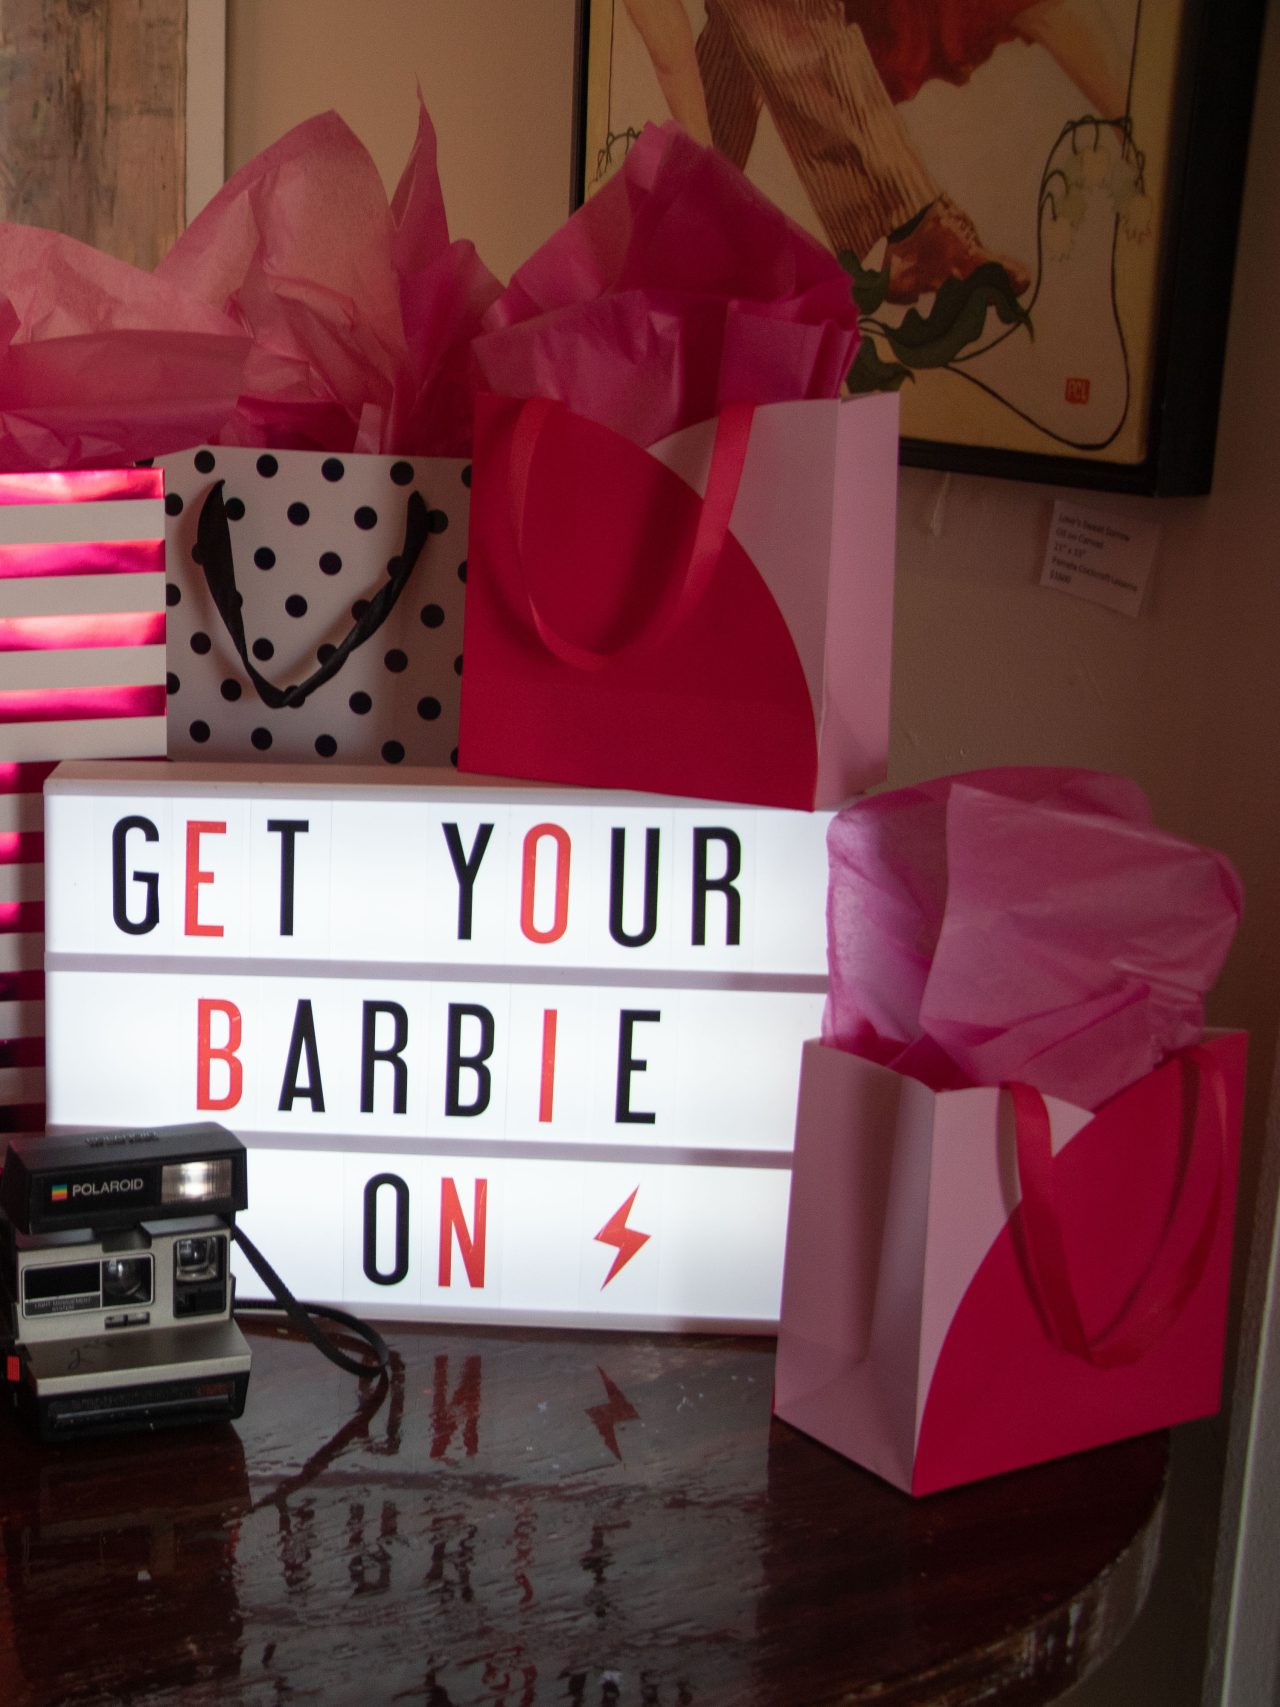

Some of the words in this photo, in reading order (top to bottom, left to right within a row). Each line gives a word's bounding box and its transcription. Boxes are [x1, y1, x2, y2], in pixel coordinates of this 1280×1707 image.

[112, 815, 310, 937] GET
[441, 822, 742, 948] YOUR
[196, 998, 661, 1125] BARBIE
[72, 1178, 144, 1198] POLAROID
[362, 1172, 488, 1289] ON
